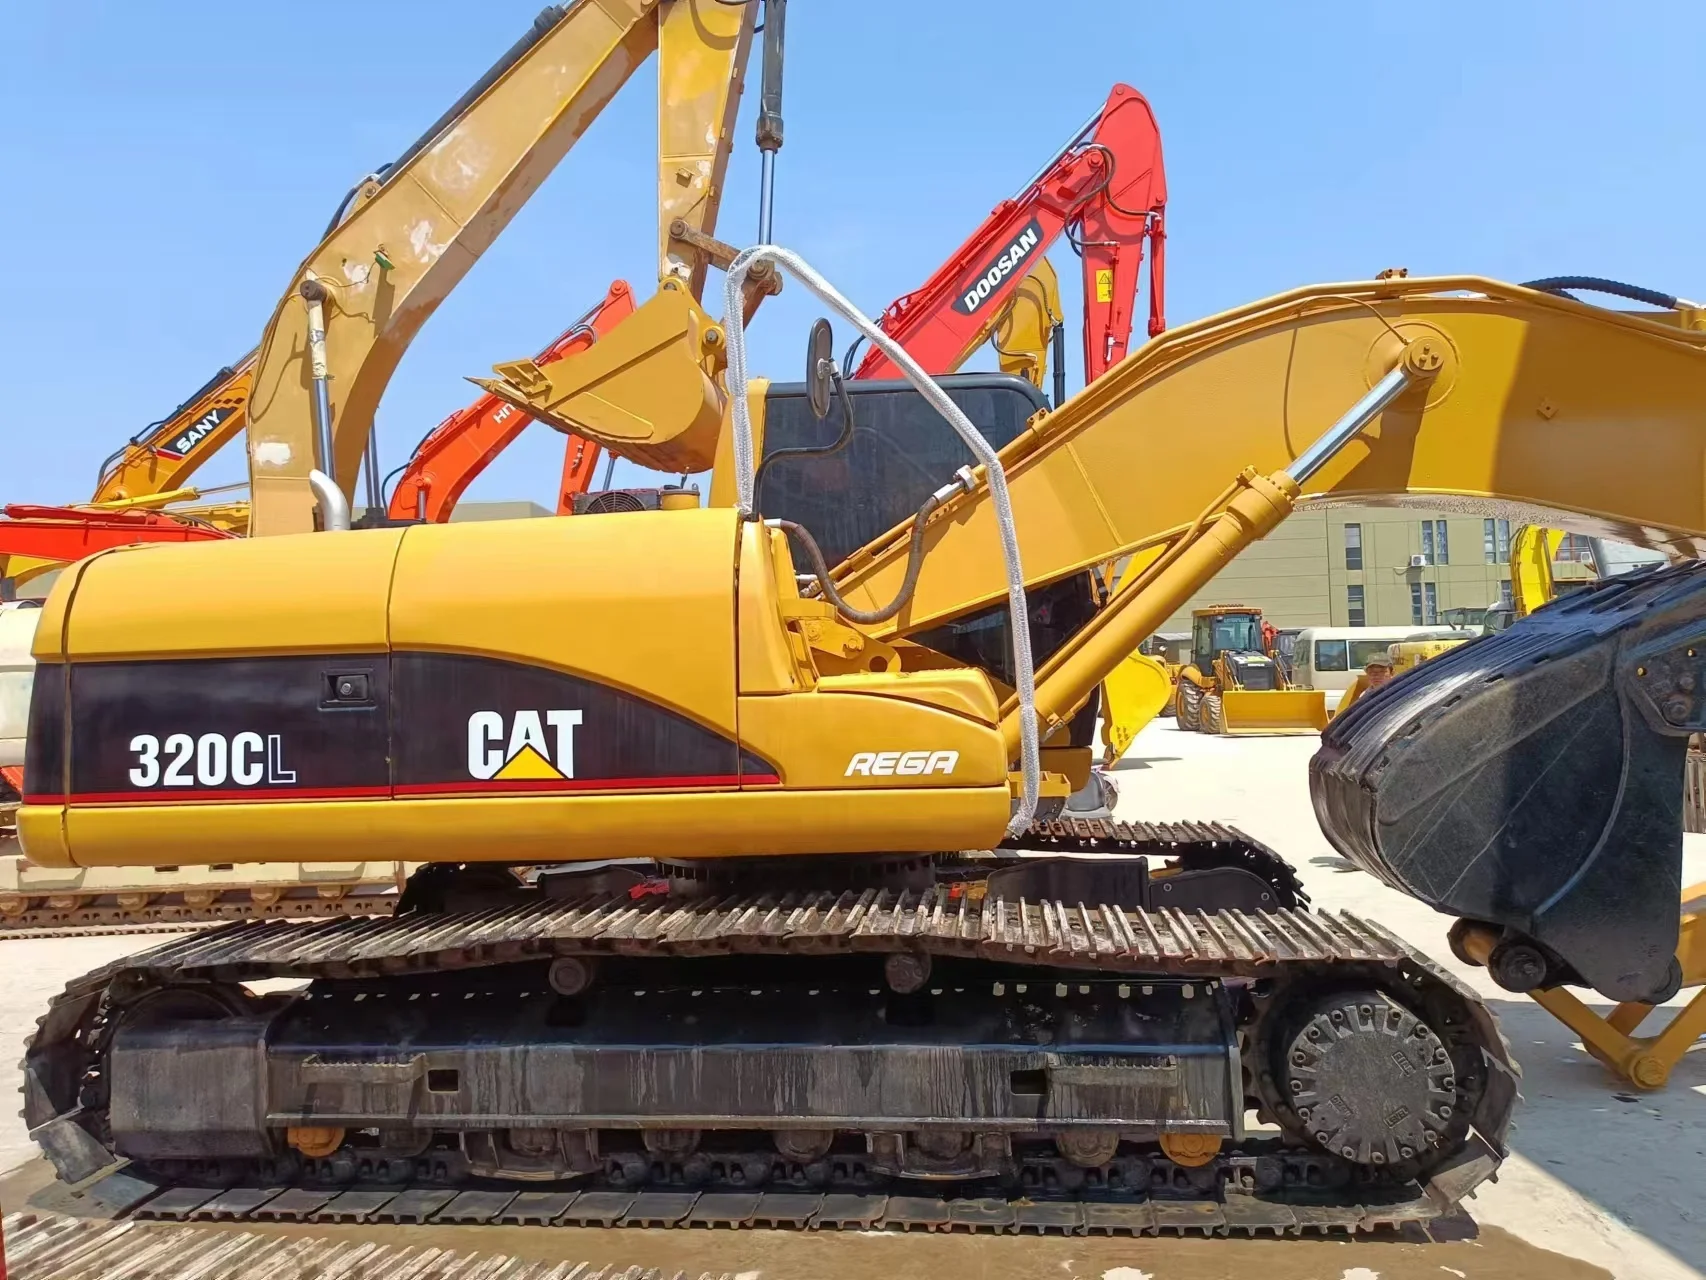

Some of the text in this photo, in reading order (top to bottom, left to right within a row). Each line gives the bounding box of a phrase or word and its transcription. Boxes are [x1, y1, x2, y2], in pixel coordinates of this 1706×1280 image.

[964, 228, 1038, 312] DOOSAN
[176, 409, 220, 453] SANY
[129, 731, 297, 787] 320CL
[468, 709, 583, 780] CAT
[844, 751, 960, 777] REGA
